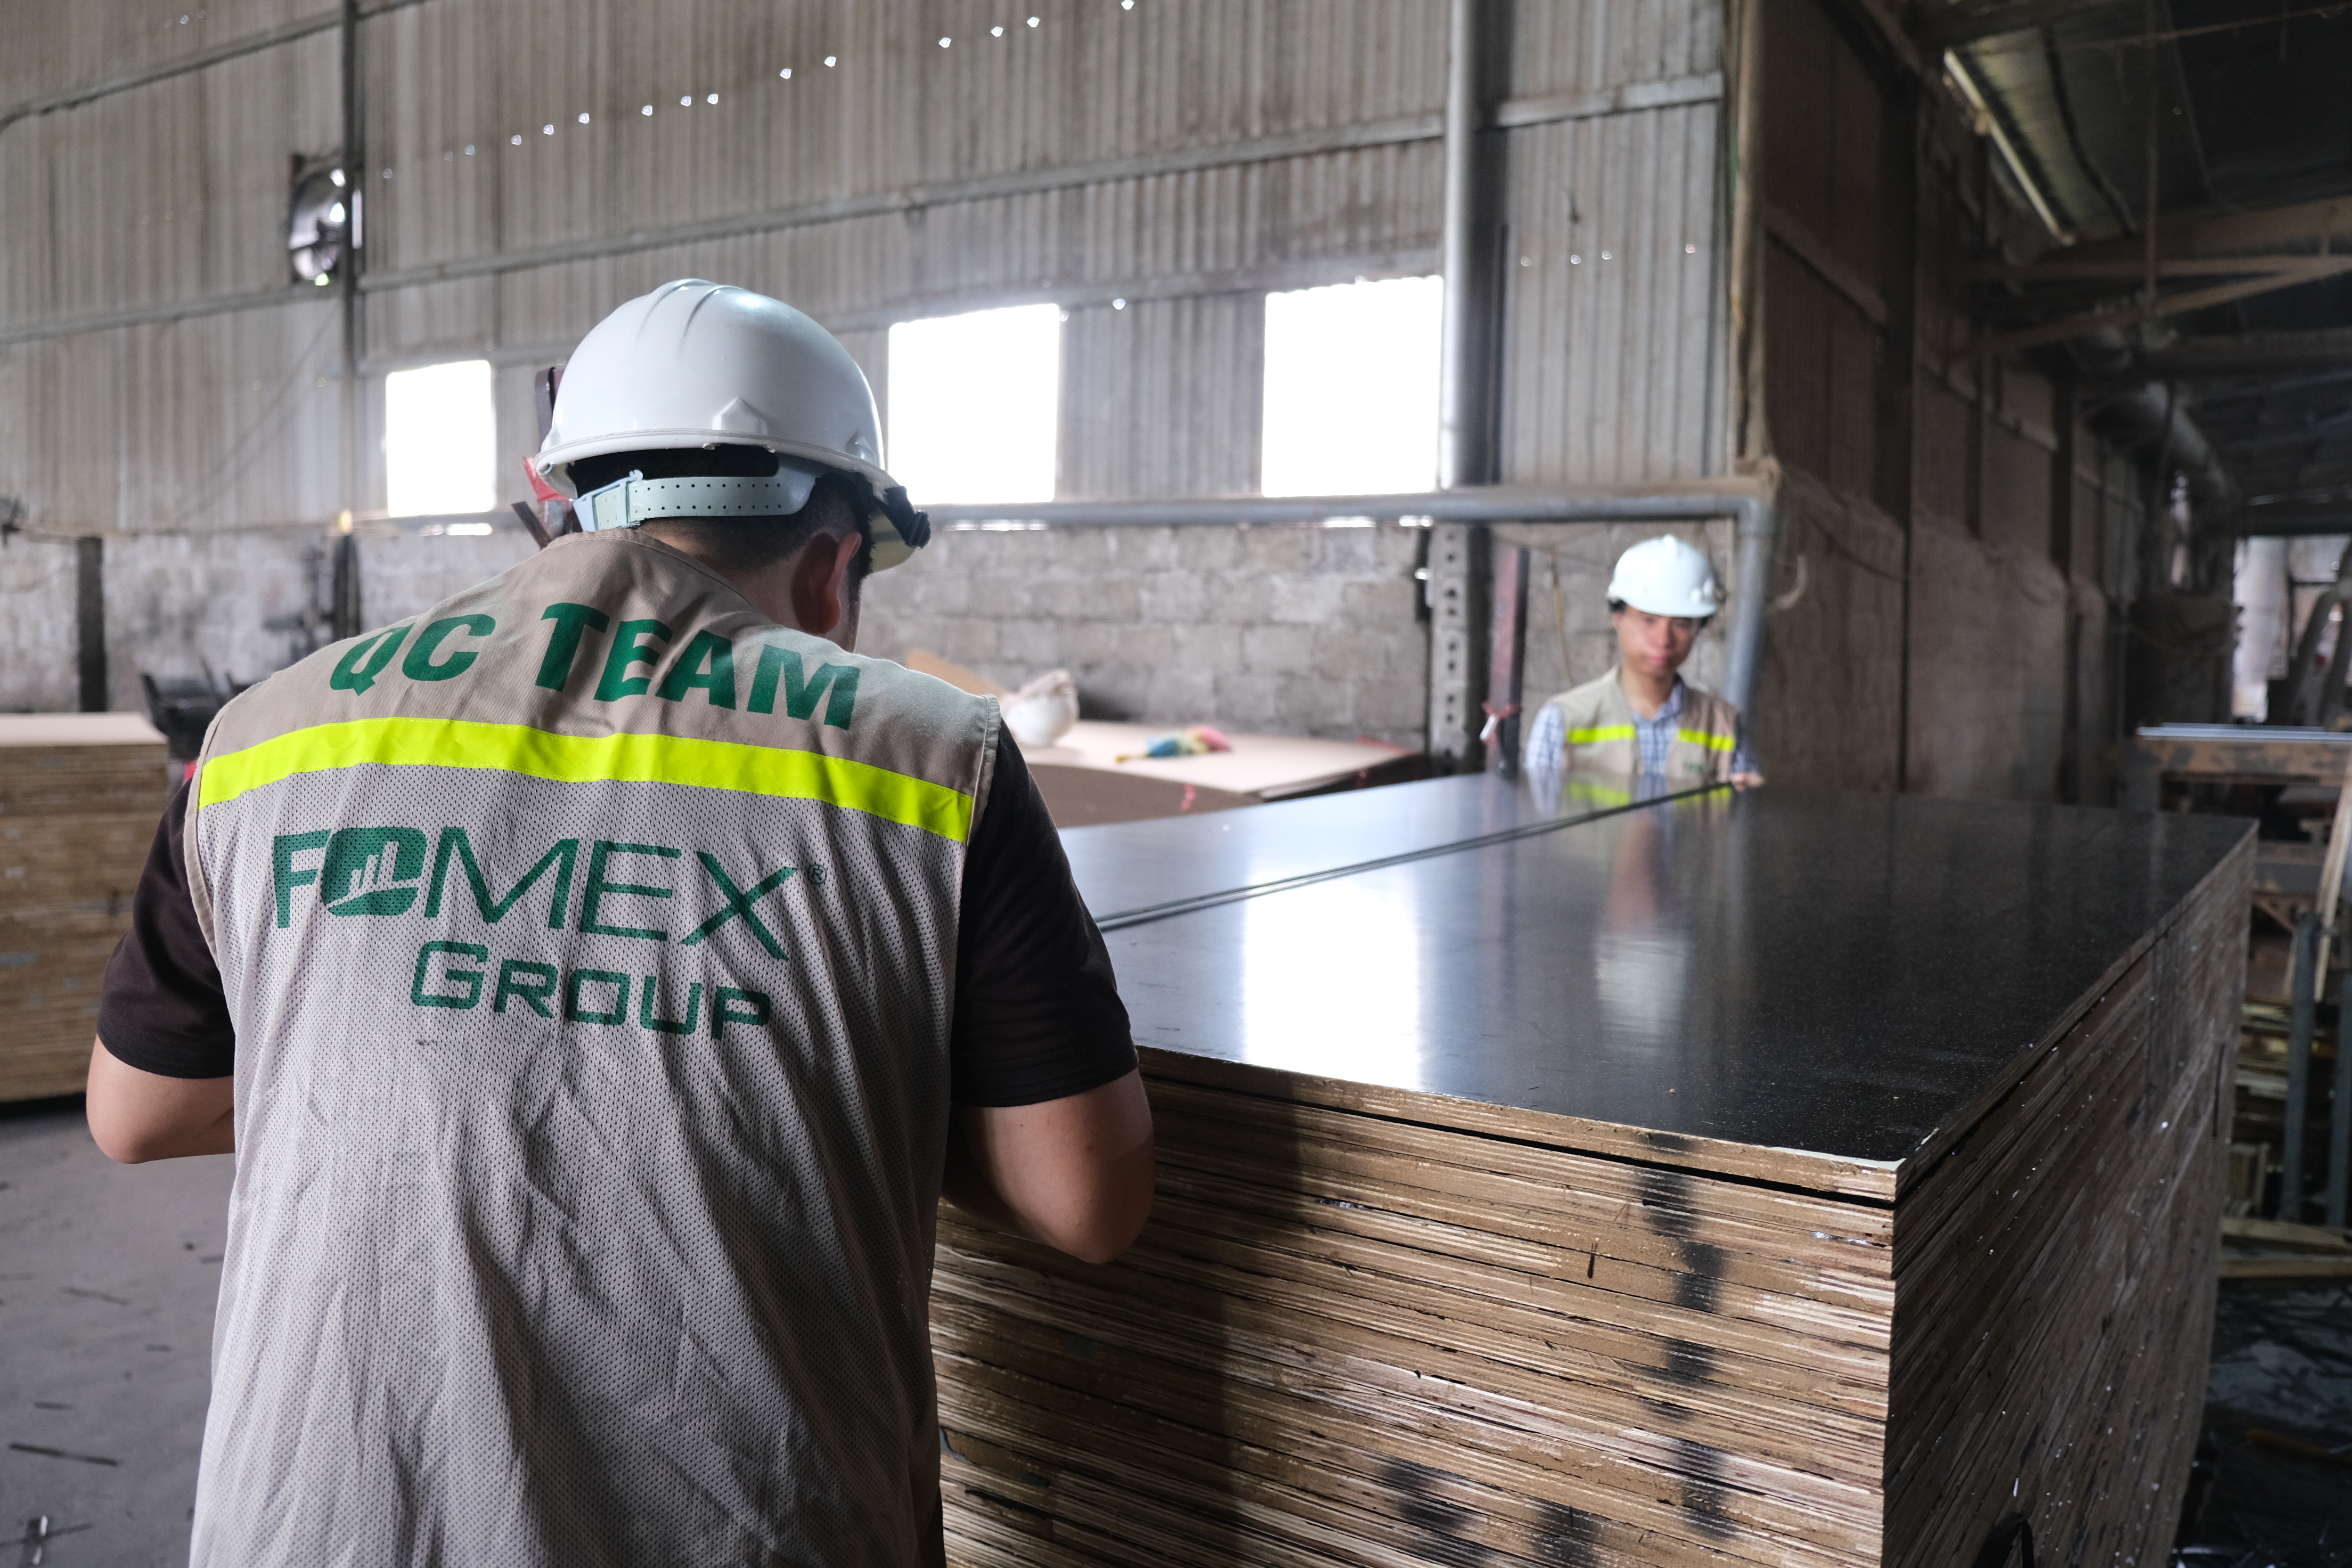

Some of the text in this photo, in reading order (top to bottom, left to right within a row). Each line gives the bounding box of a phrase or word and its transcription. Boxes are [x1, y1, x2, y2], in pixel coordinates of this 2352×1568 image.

[329, 602, 860, 730] QC TEAM
[411, 940, 771, 1040] GROUP
